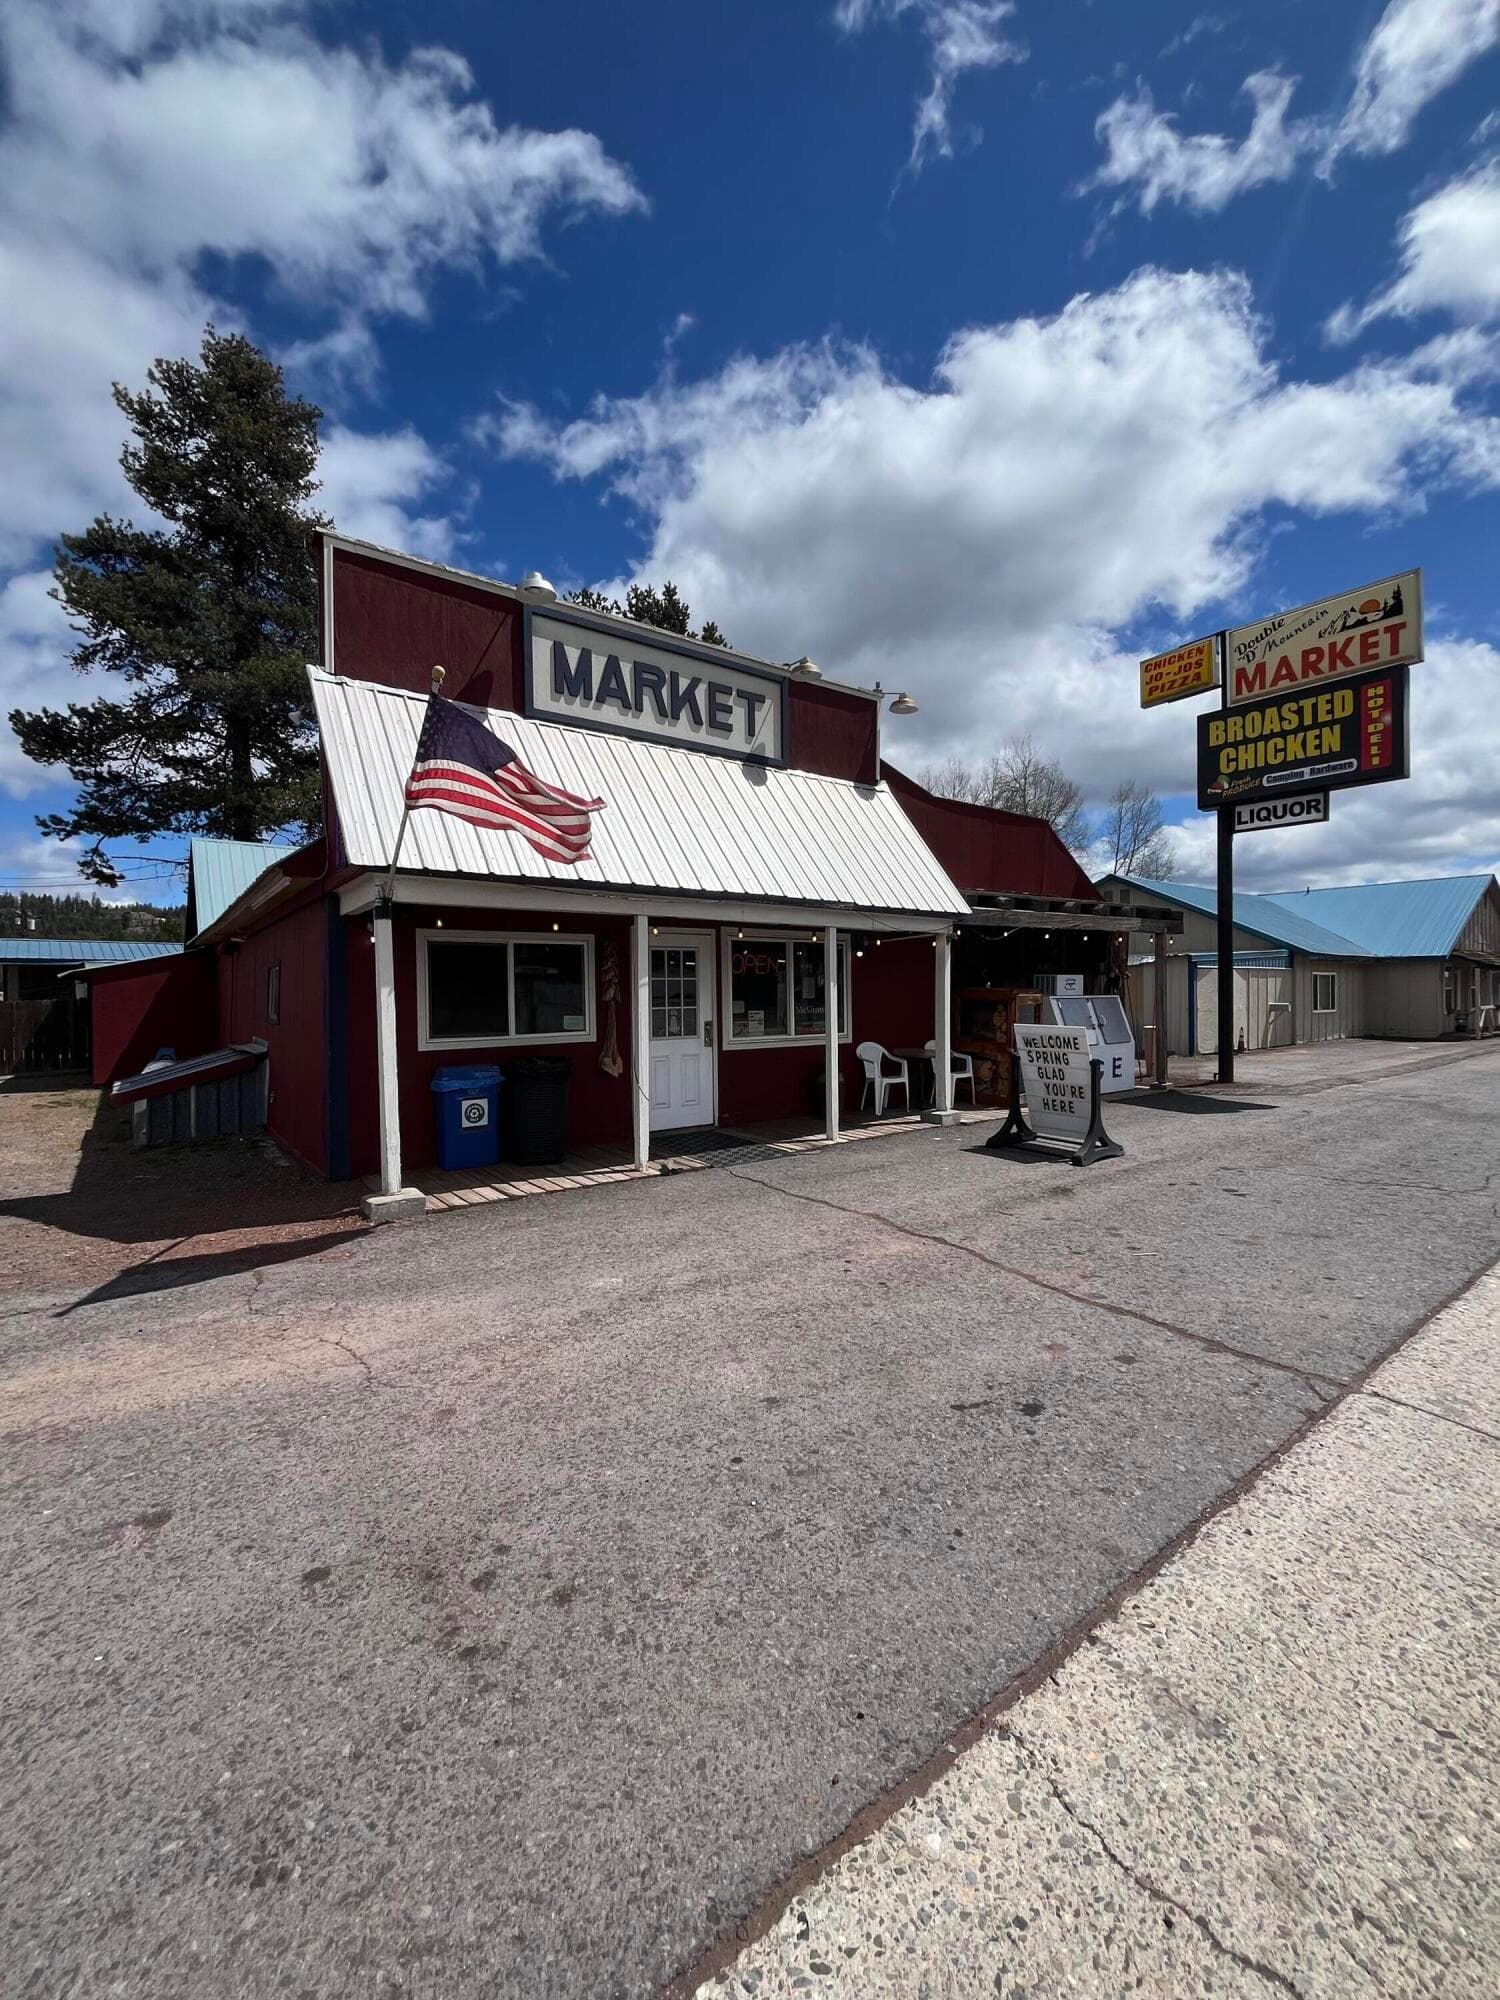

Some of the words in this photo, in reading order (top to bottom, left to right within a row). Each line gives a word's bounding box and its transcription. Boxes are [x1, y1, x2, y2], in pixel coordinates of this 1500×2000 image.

[1234, 617, 1286, 656] Double
[1262, 609, 1329, 659] Mountain
[1144, 645, 1205, 673] CHICKEN
[1145, 658, 1204, 686] JO-JOS
[1235, 621, 1407, 697] MARKET
[553, 640, 766, 738] MARKET
[1148, 671, 1202, 697] PIZZA
[1367, 686, 1384, 719] HOT
[1209, 689, 1354, 747] BROASTED
[1219, 724, 1341, 774] CHICKEN
[1367, 722, 1384, 766] DELI
[1266, 769, 1305, 784] Camping
[1309, 761, 1354, 777] Hardware
[1222, 777, 1261, 799] PRODUCE
[1236, 798, 1322, 826] LIQUOR
[732, 953, 779, 976] OPEN
[1022, 1035, 1080, 1050] WELCOME
[1027, 1050, 1070, 1066] SPRING
[1037, 1066, 1065, 1081] GLAD
[1043, 1082, 1085, 1100] YOU'RE
[1042, 1097, 1075, 1114] HERE
